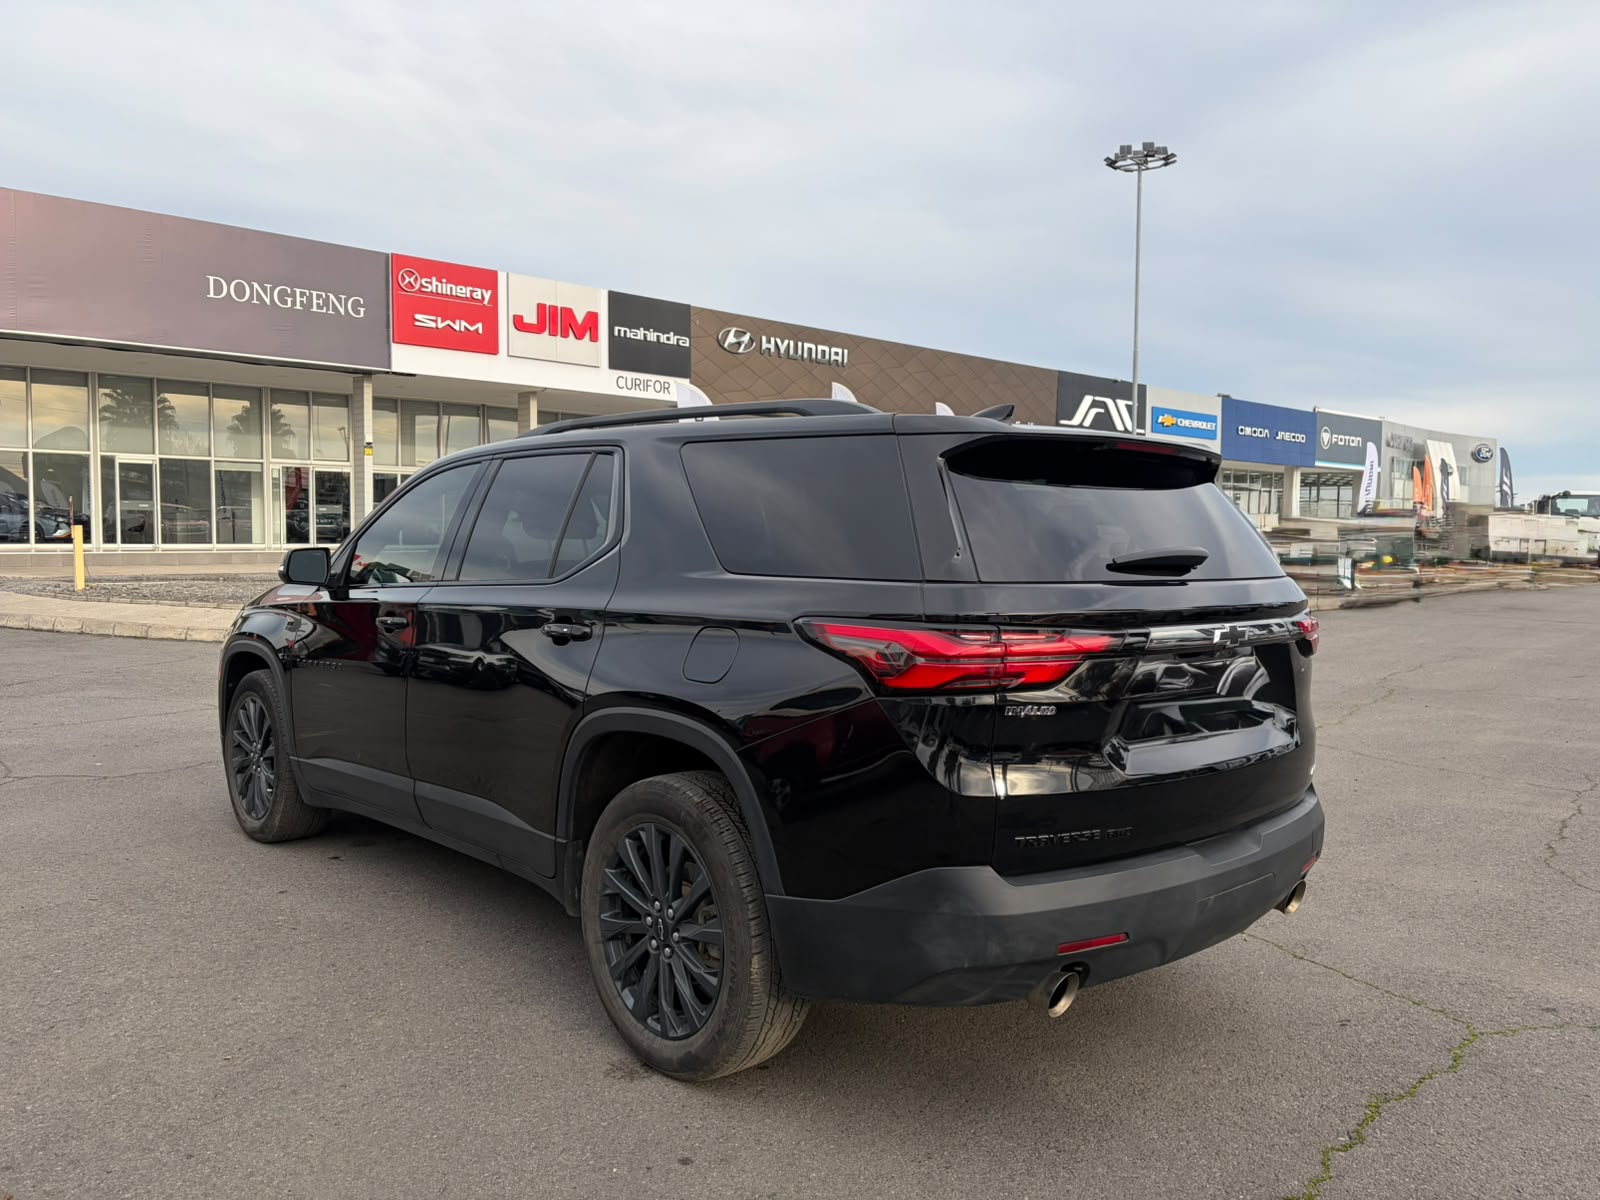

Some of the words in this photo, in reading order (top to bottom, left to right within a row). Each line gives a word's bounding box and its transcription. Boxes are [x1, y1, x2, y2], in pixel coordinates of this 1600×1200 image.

[205, 275, 366, 319] DONGFENG
[413, 313, 483, 334] SWM
[513, 303, 599, 343] JIM
[613, 325, 690, 348] mahindra
[760, 335, 849, 367] HYUNDAI
[616, 375, 672, 396] CURIFOR
[1177, 418, 1217, 431] CHEVROLET
[1331, 434, 1362, 448] FOTON
